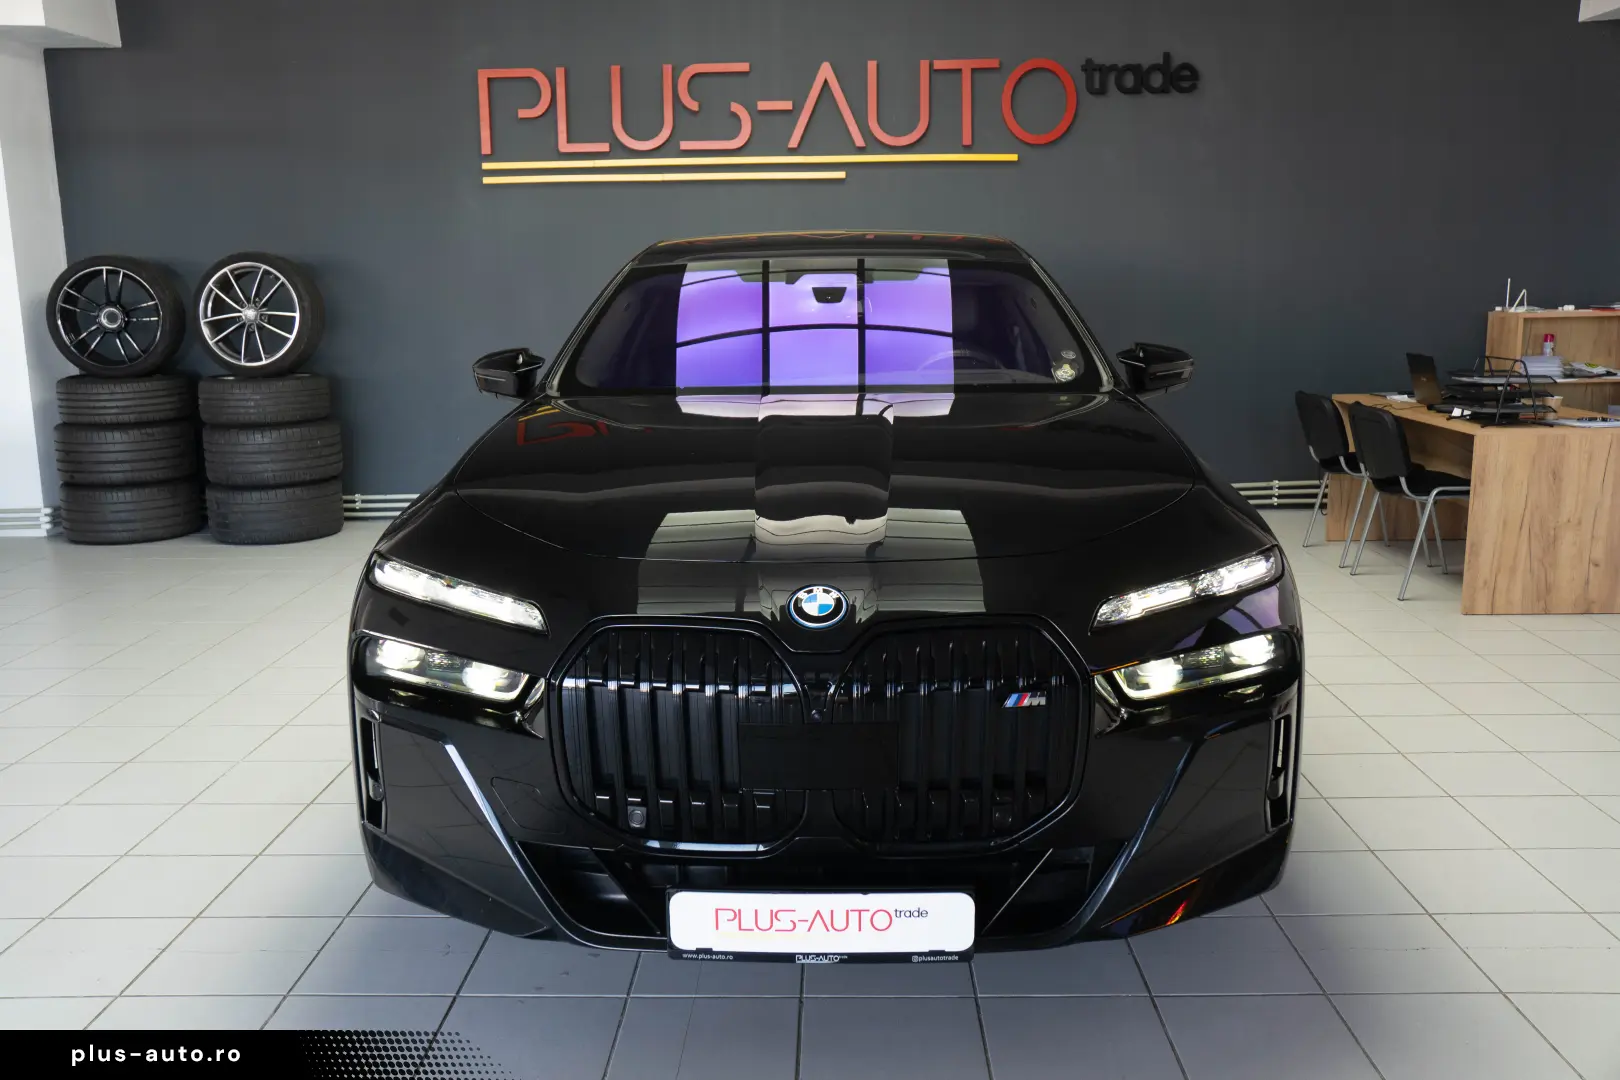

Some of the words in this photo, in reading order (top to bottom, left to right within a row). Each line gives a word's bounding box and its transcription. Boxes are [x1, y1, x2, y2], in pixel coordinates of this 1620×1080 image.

[477, 57, 1078, 155] PLUS-AUTO
[1081, 52, 1200, 95] trade
[797, 587, 840, 599] BMW
[715, 908, 892, 931] PLUS-AUTO
[894, 907, 929, 918] trade
[795, 954, 840, 963] PLUS-AUTO
